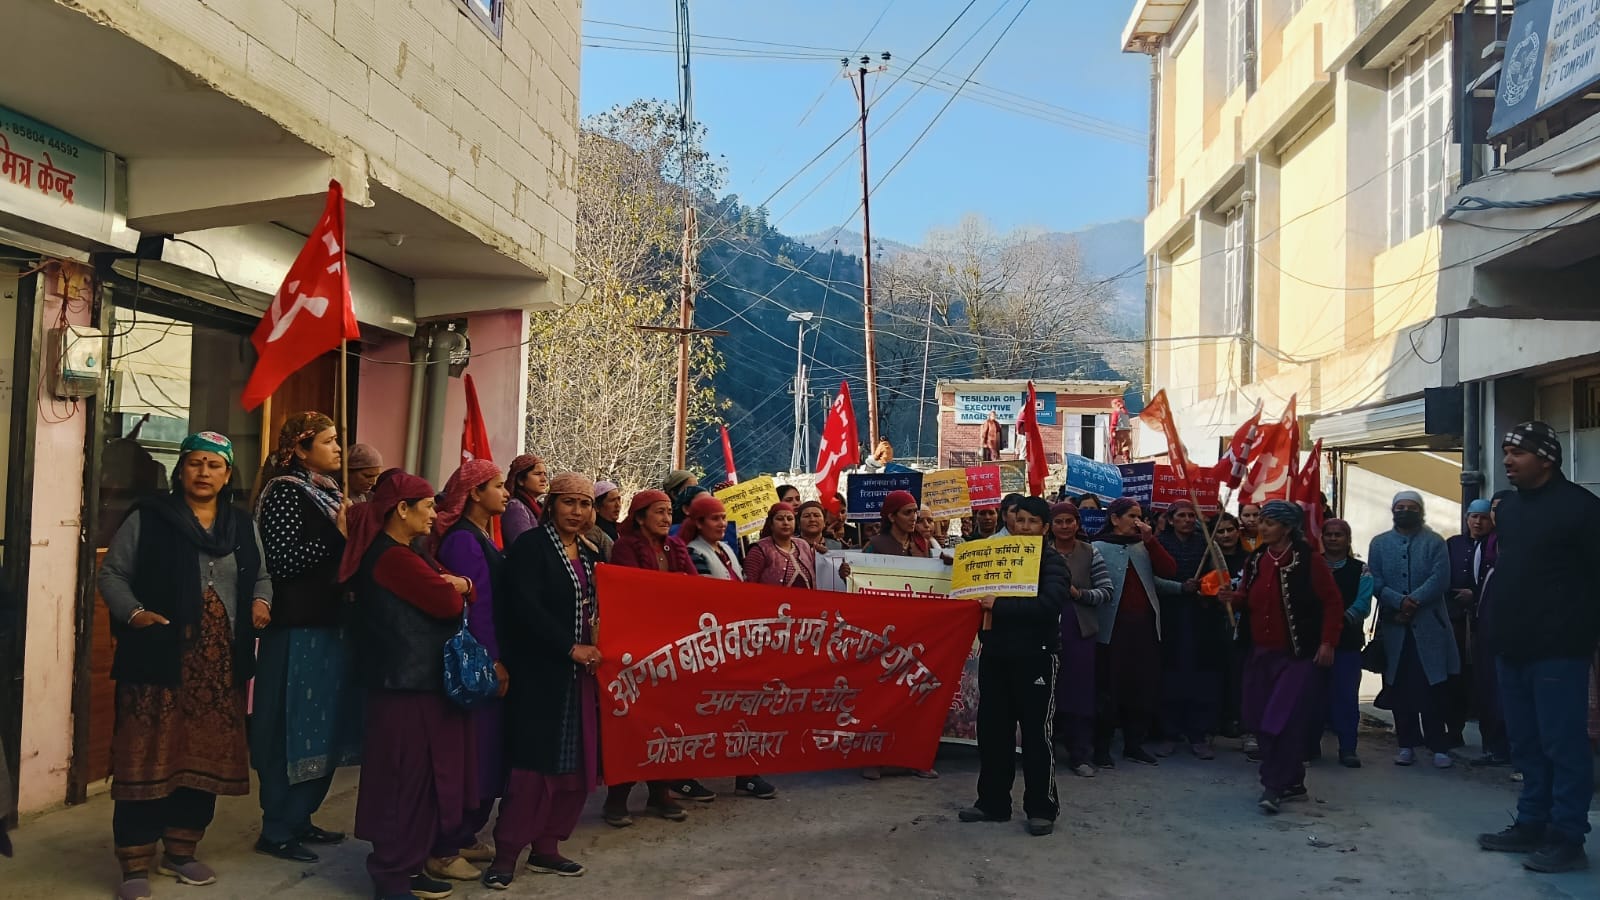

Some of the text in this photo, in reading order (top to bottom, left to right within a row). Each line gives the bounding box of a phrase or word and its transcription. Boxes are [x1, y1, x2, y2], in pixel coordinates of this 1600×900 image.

[1554, 4, 1587, 39] COMPANY
[1551, 40, 1569, 62] HOME
[1560, 46, 1596, 81] COMPANY
[48, 137, 79, 158] 44592
[958, 543, 1035, 561] आंगनवाड़ी कर्मियों को
[965, 556, 1024, 573] हरियाणा की तर्ज
[972, 569, 1012, 582] पर वेतन दो
[608, 643, 678, 716] आंगन
[675, 612, 726, 673] बाड़ी
[794, 610, 828, 656] एवं
[637, 723, 718, 767] प्रोजेक्ट
